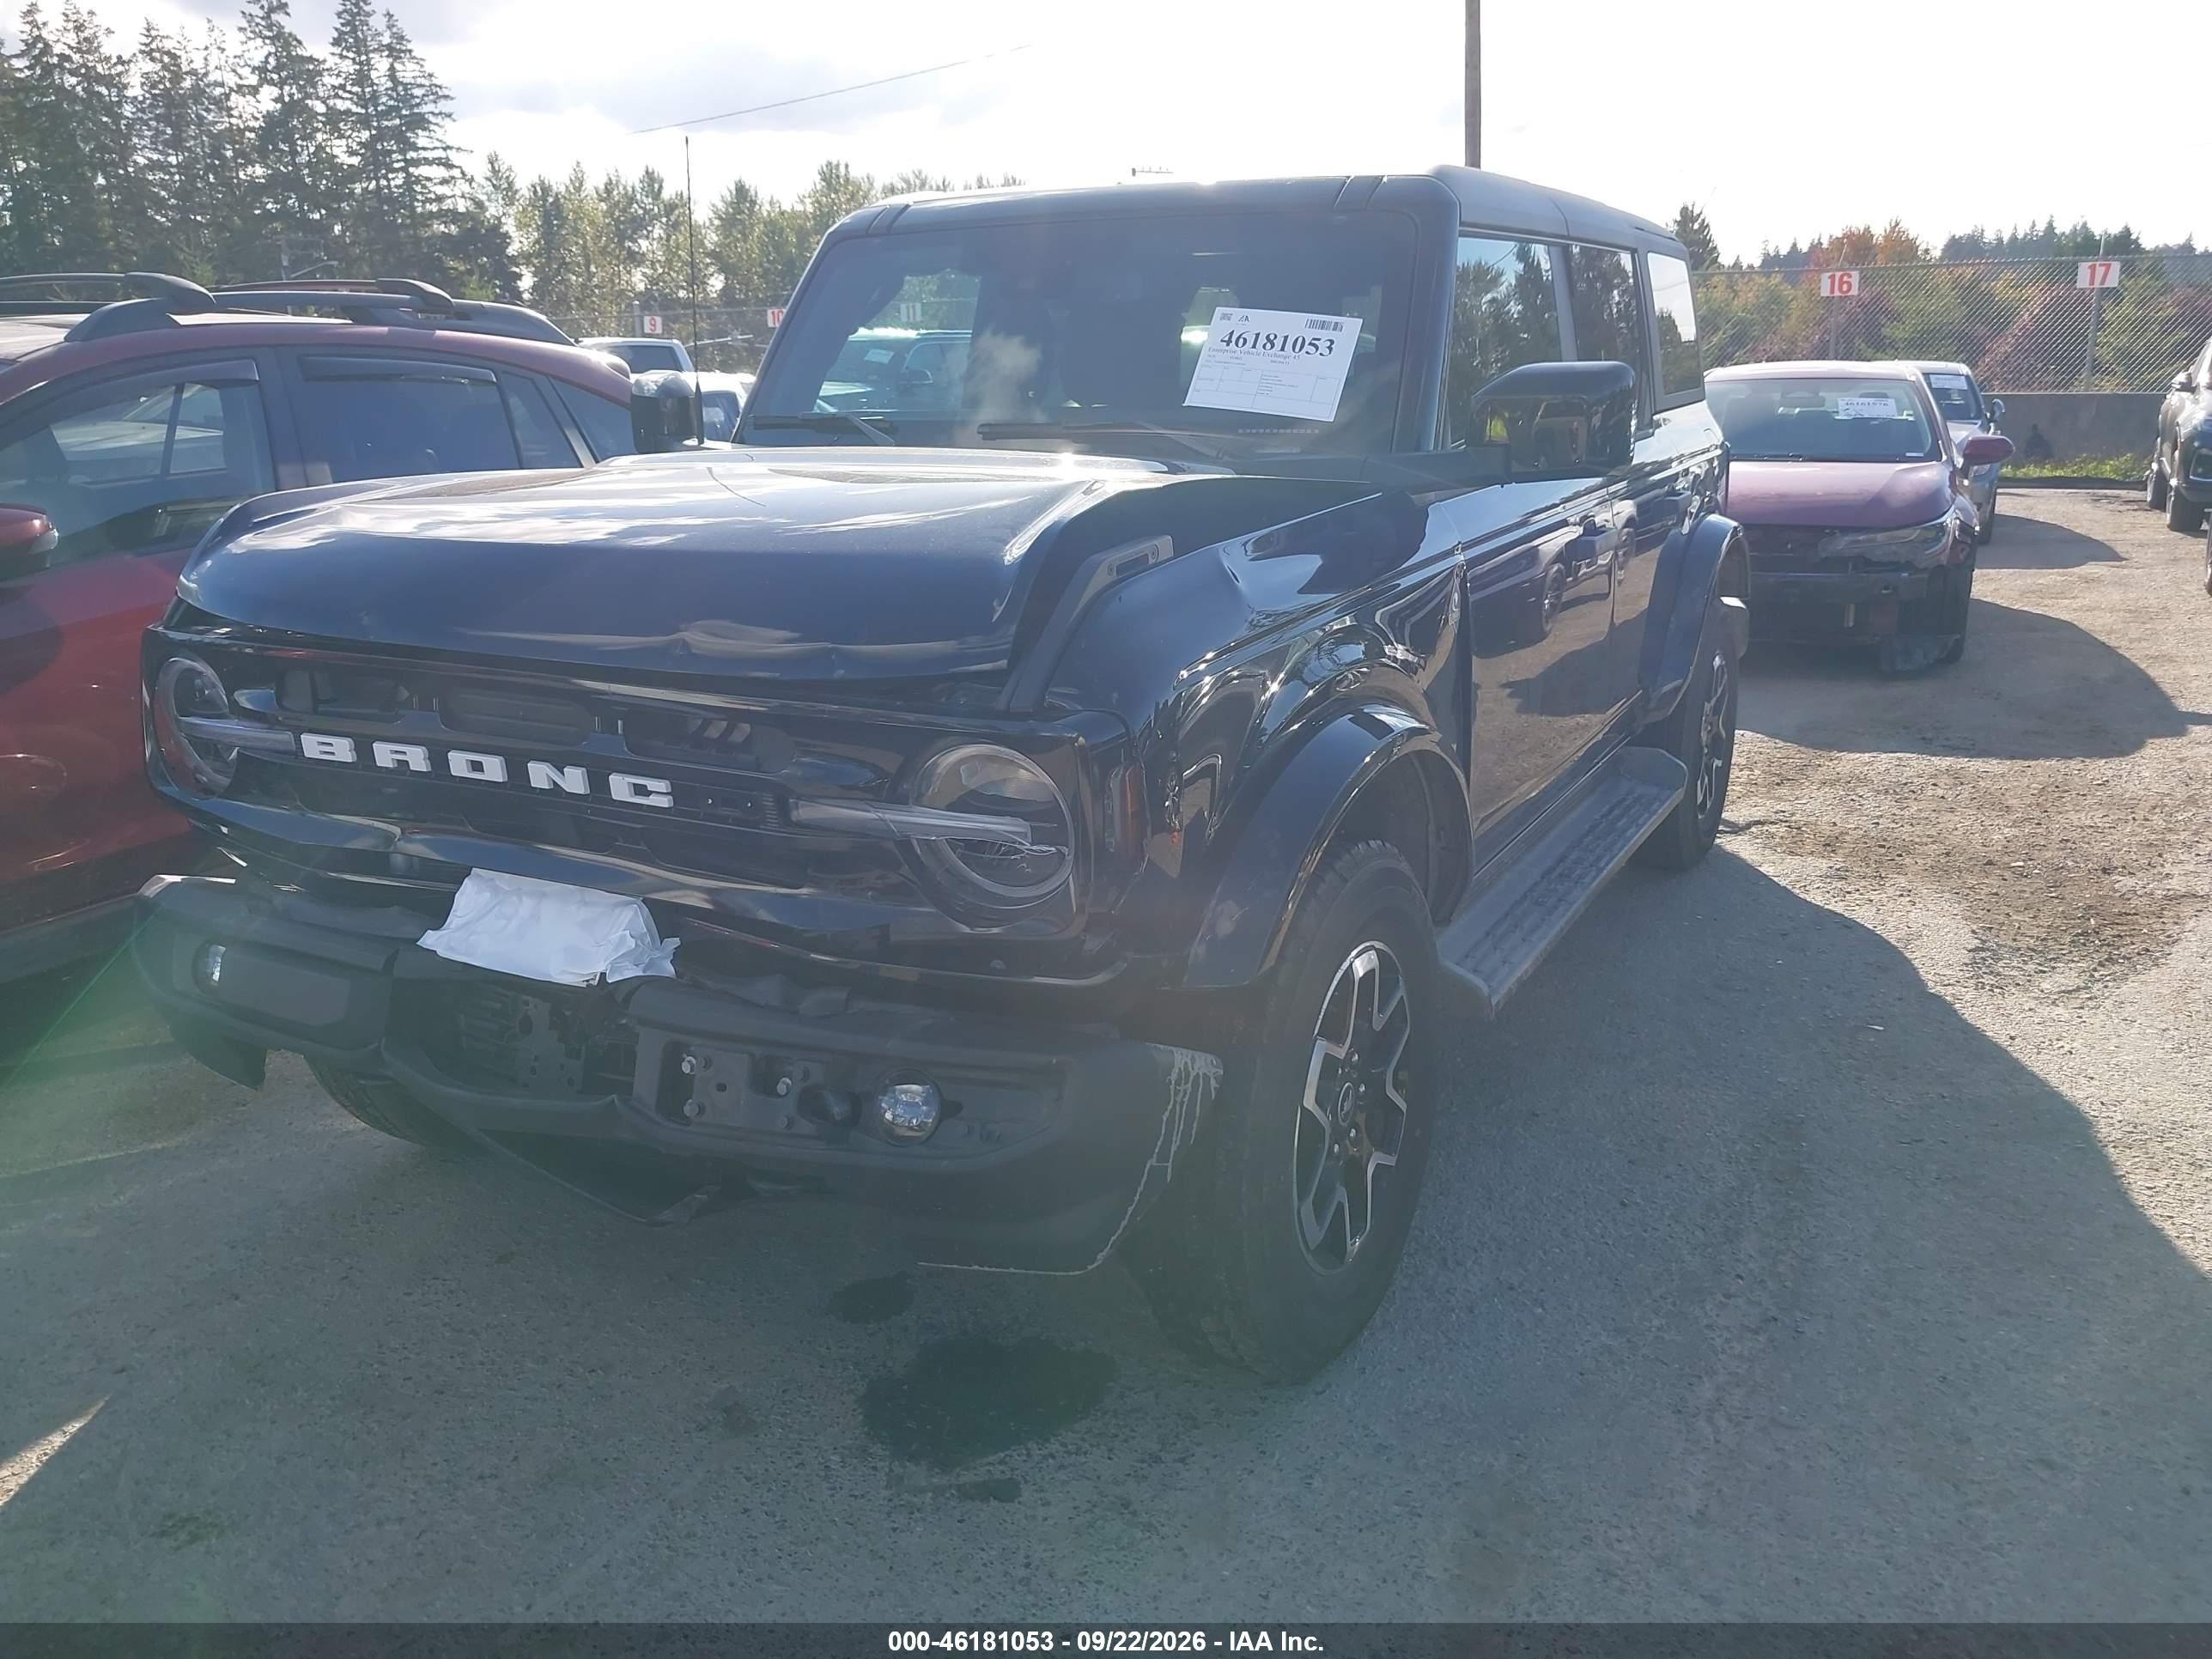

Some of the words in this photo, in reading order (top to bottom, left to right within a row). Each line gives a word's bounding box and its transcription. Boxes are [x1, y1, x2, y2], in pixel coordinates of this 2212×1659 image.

[1827, 272, 1853, 296] 16
[2087, 262, 2112, 286] 17
[648, 316, 658, 332] 9
[1220, 329, 1335, 357] 46181053
[1262, 351, 1291, 360] Exchange
[300, 732, 675, 808] BRONC
